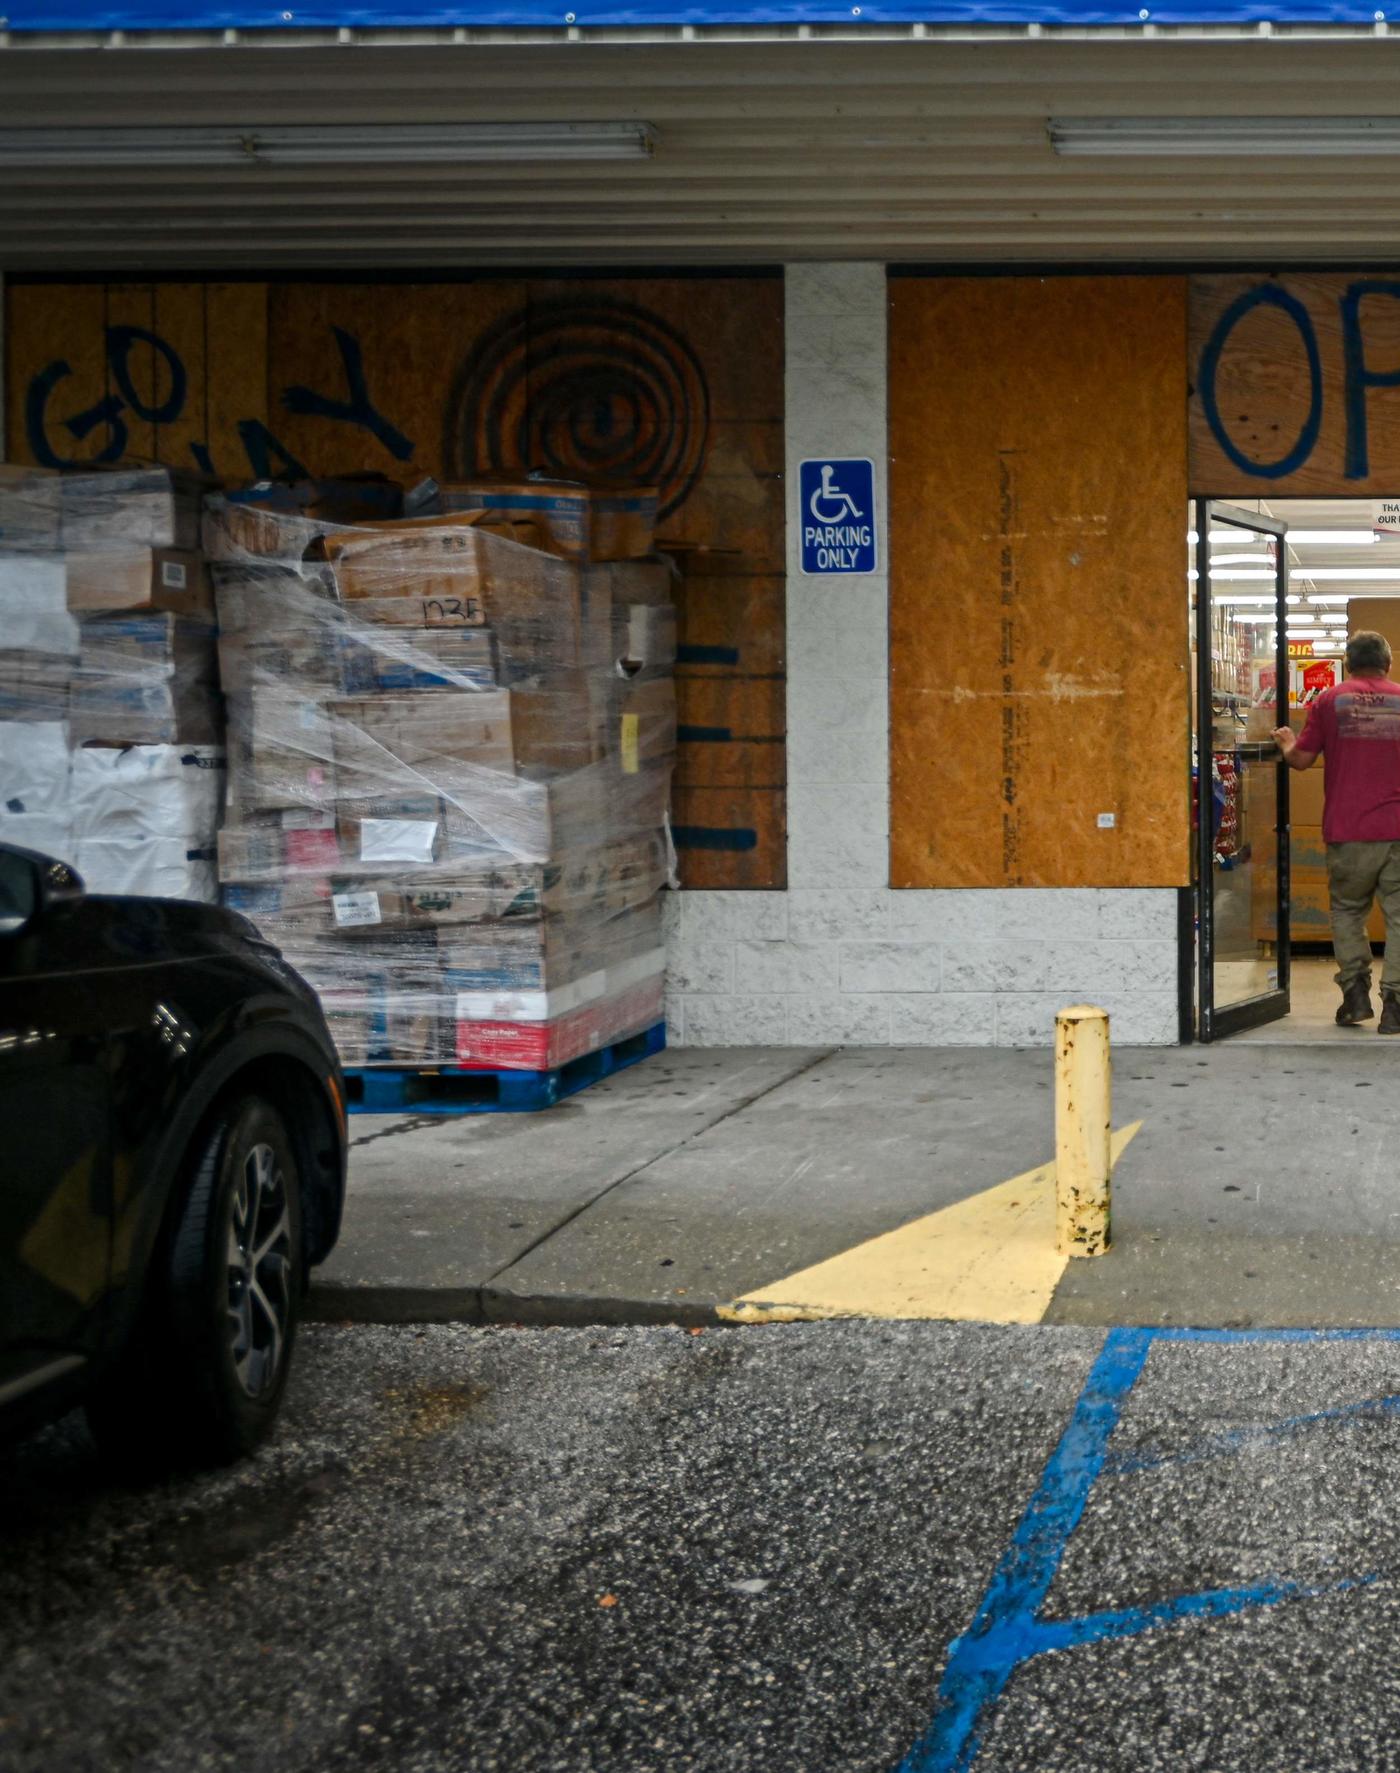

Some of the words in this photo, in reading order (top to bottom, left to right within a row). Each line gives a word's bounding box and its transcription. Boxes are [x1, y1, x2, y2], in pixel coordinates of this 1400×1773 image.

[25, 325, 188, 469] GO
[1377, 515, 1397, 524] OUR
[804, 525, 871, 547] PARKING
[817, 547, 859, 569] ONLY
